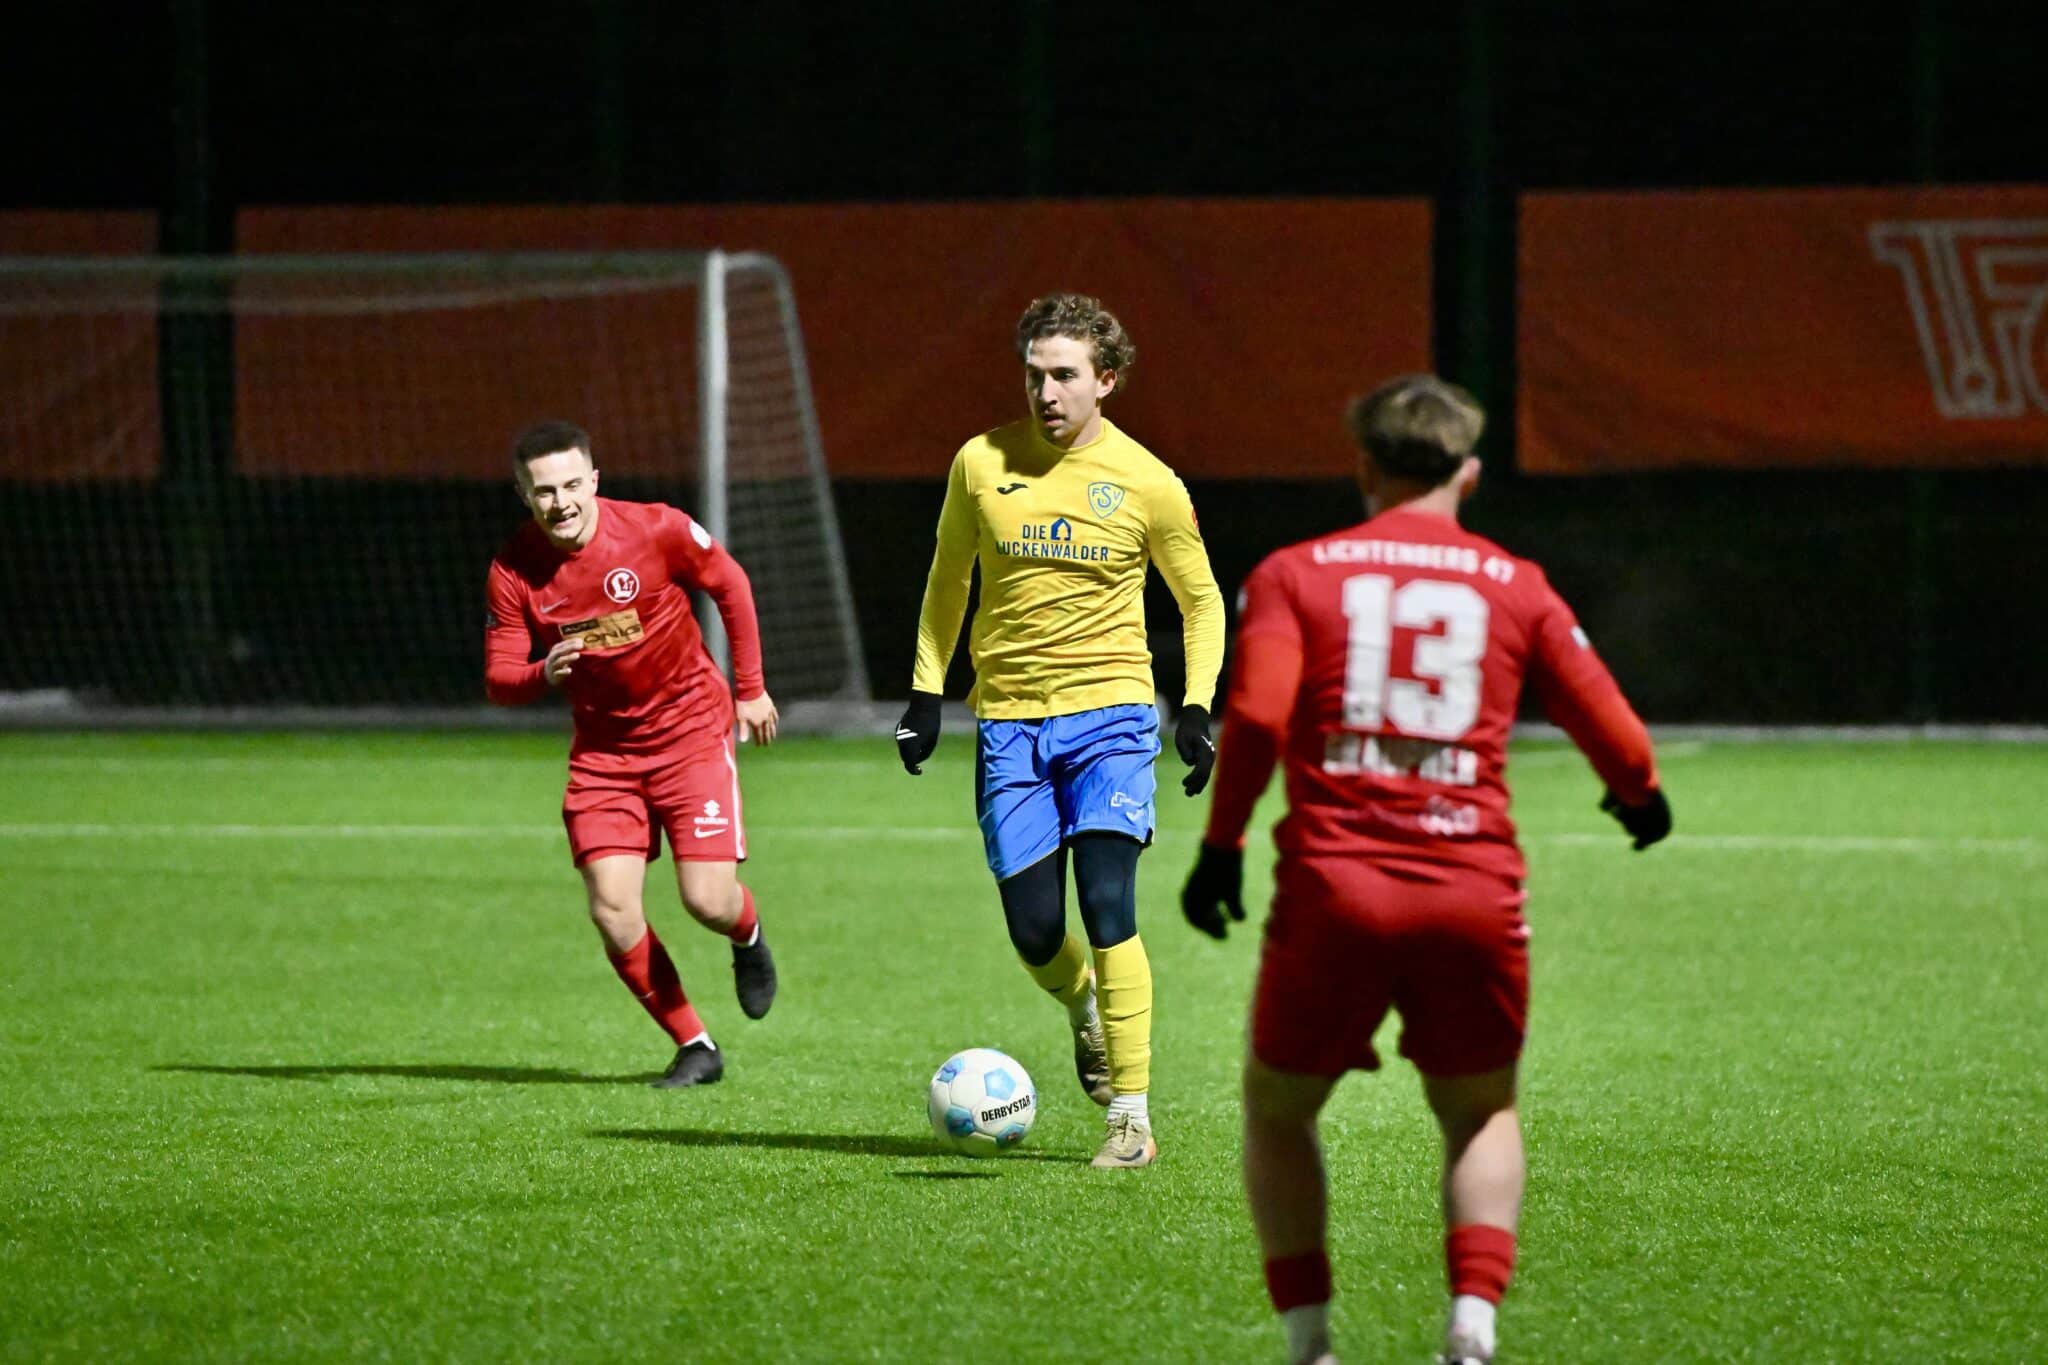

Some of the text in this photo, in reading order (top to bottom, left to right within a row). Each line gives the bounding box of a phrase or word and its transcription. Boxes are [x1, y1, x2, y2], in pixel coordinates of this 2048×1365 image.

[1092, 485, 1121, 508] FSV
[1022, 524, 1046, 540] DIE
[1342, 573, 1489, 741] 13
[981, 1095, 1031, 1122] DERBYSTAR
